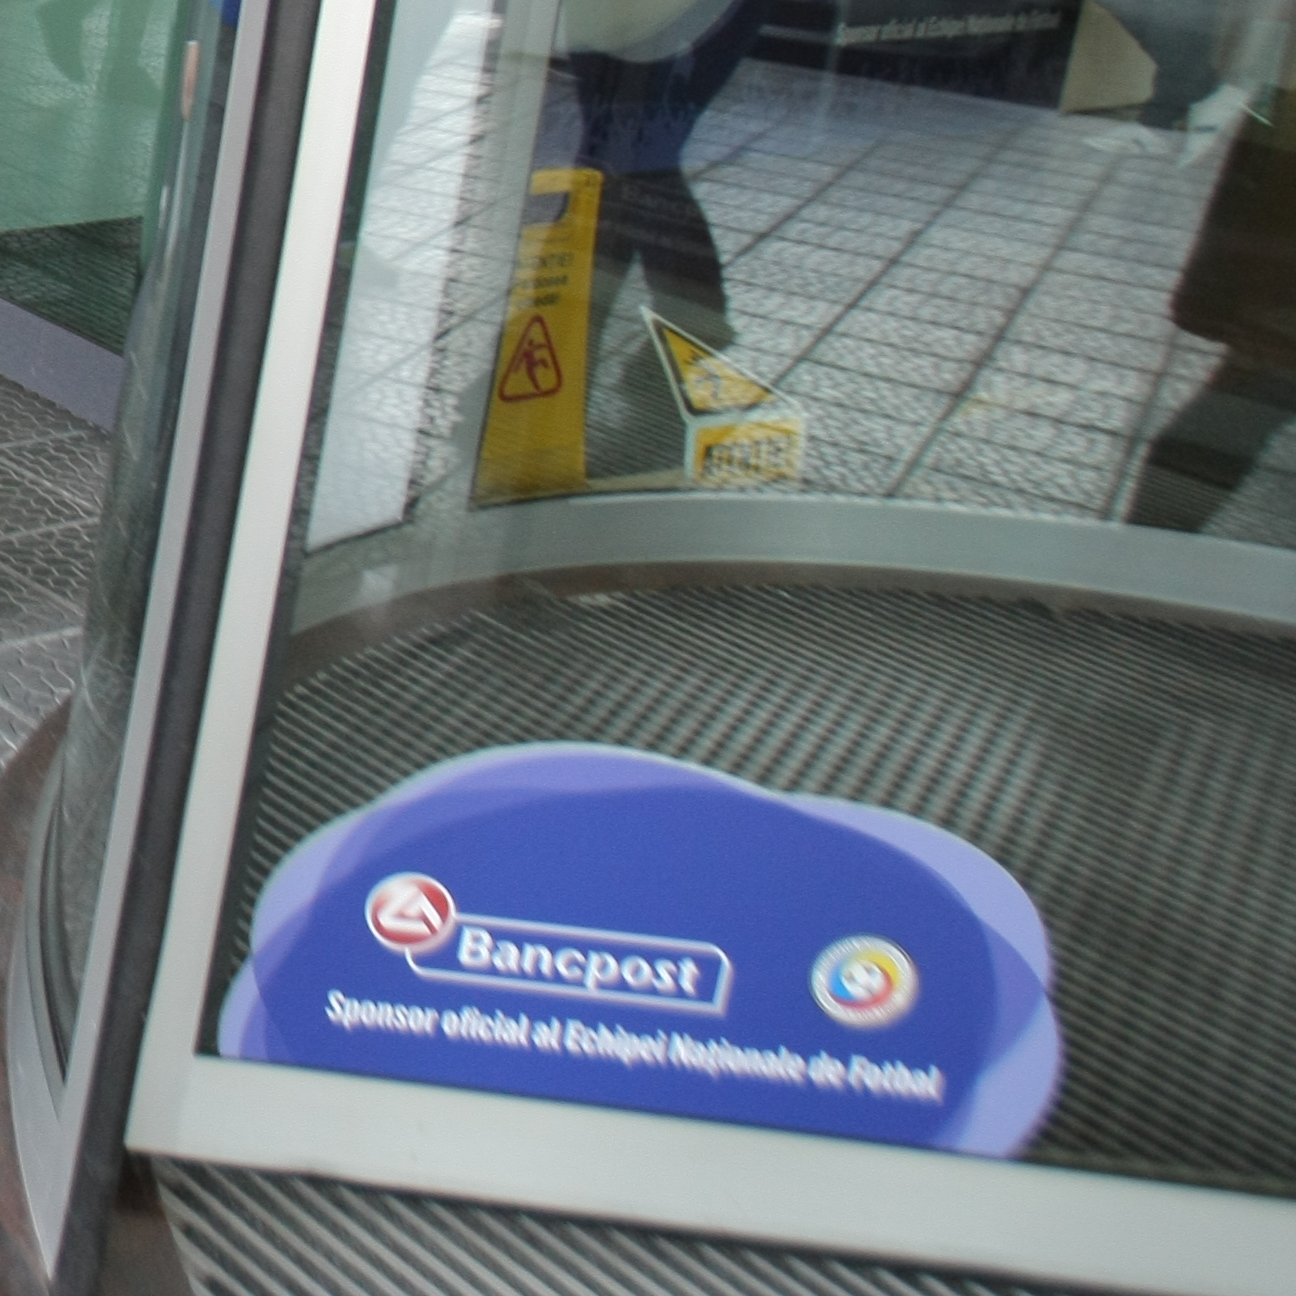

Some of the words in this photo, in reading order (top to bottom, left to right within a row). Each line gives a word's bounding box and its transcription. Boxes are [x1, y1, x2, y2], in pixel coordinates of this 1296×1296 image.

[456, 924, 702, 997] Bancpost
[325, 988, 440, 1039] Sponsor
[441, 1005, 530, 1050] oficial
[532, 1015, 565, 1055] al
[563, 1017, 668, 1070] Echipei
[808, 1049, 848, 1093] de
[847, 1053, 948, 1105] Fotbal
